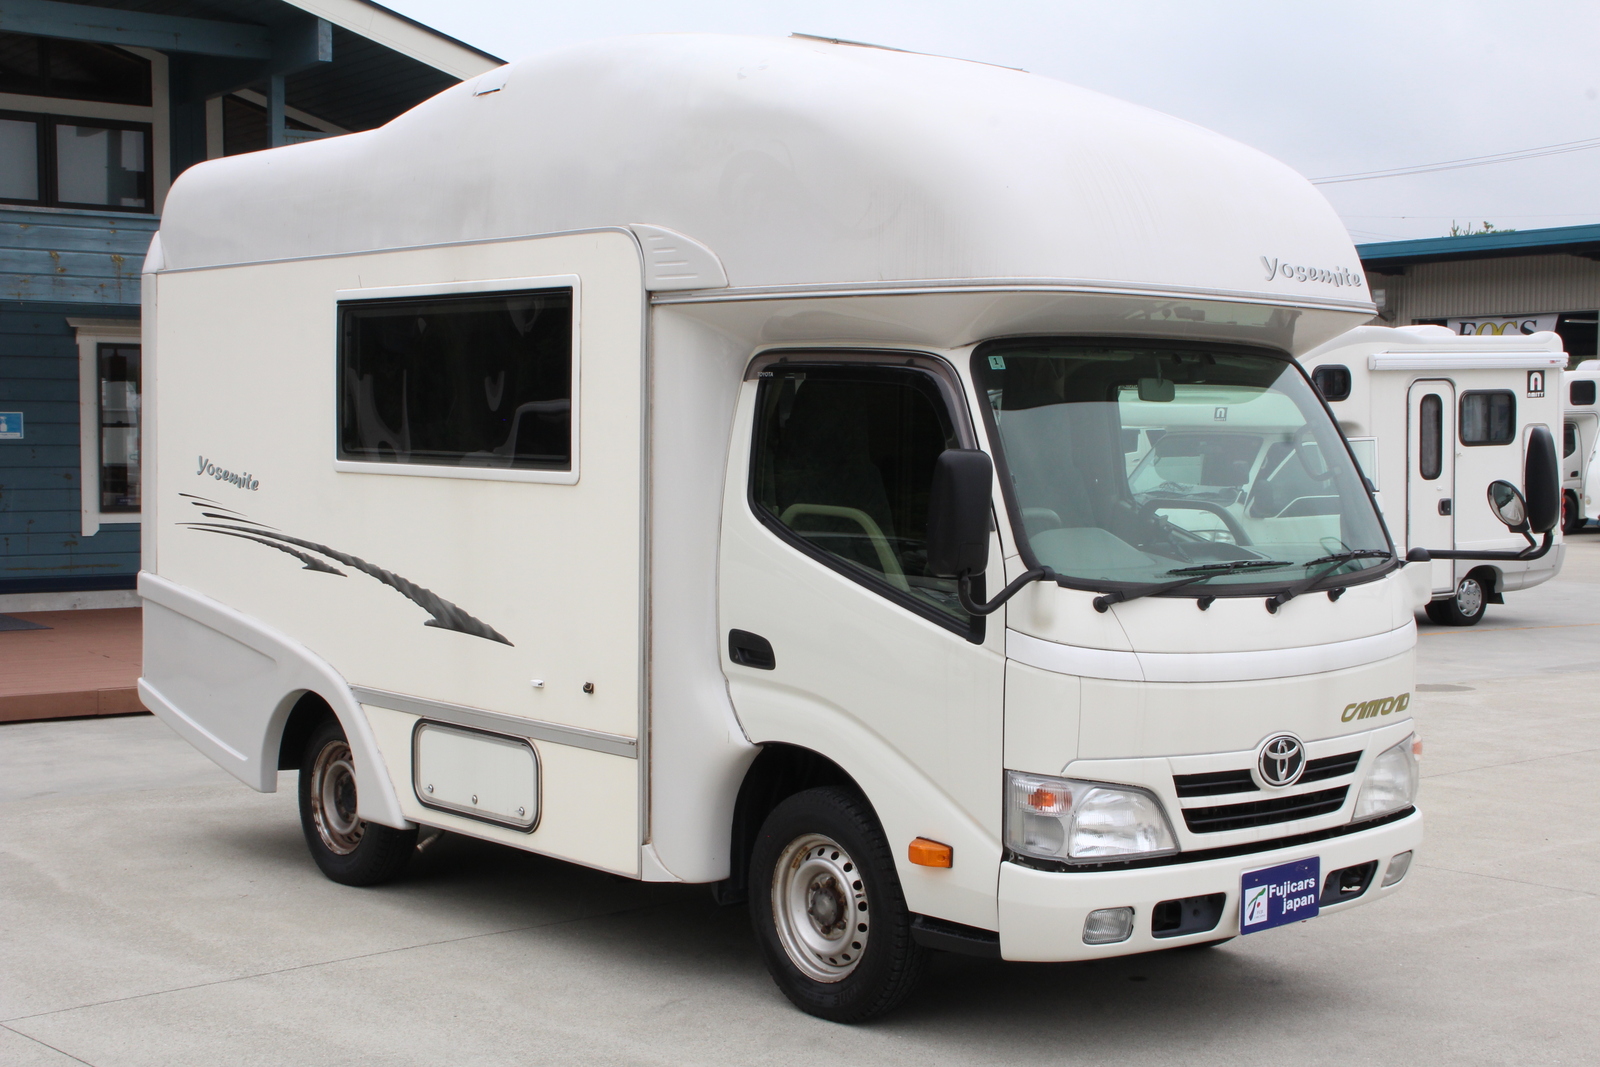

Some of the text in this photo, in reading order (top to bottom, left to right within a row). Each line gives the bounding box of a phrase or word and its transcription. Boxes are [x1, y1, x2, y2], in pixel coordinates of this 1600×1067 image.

[1260, 255, 1362, 288] Yosemite
[196, 454, 260, 492] Yosemite
[1268, 877, 1316, 899] Fujicars
[1281, 893, 1315, 915] japan
